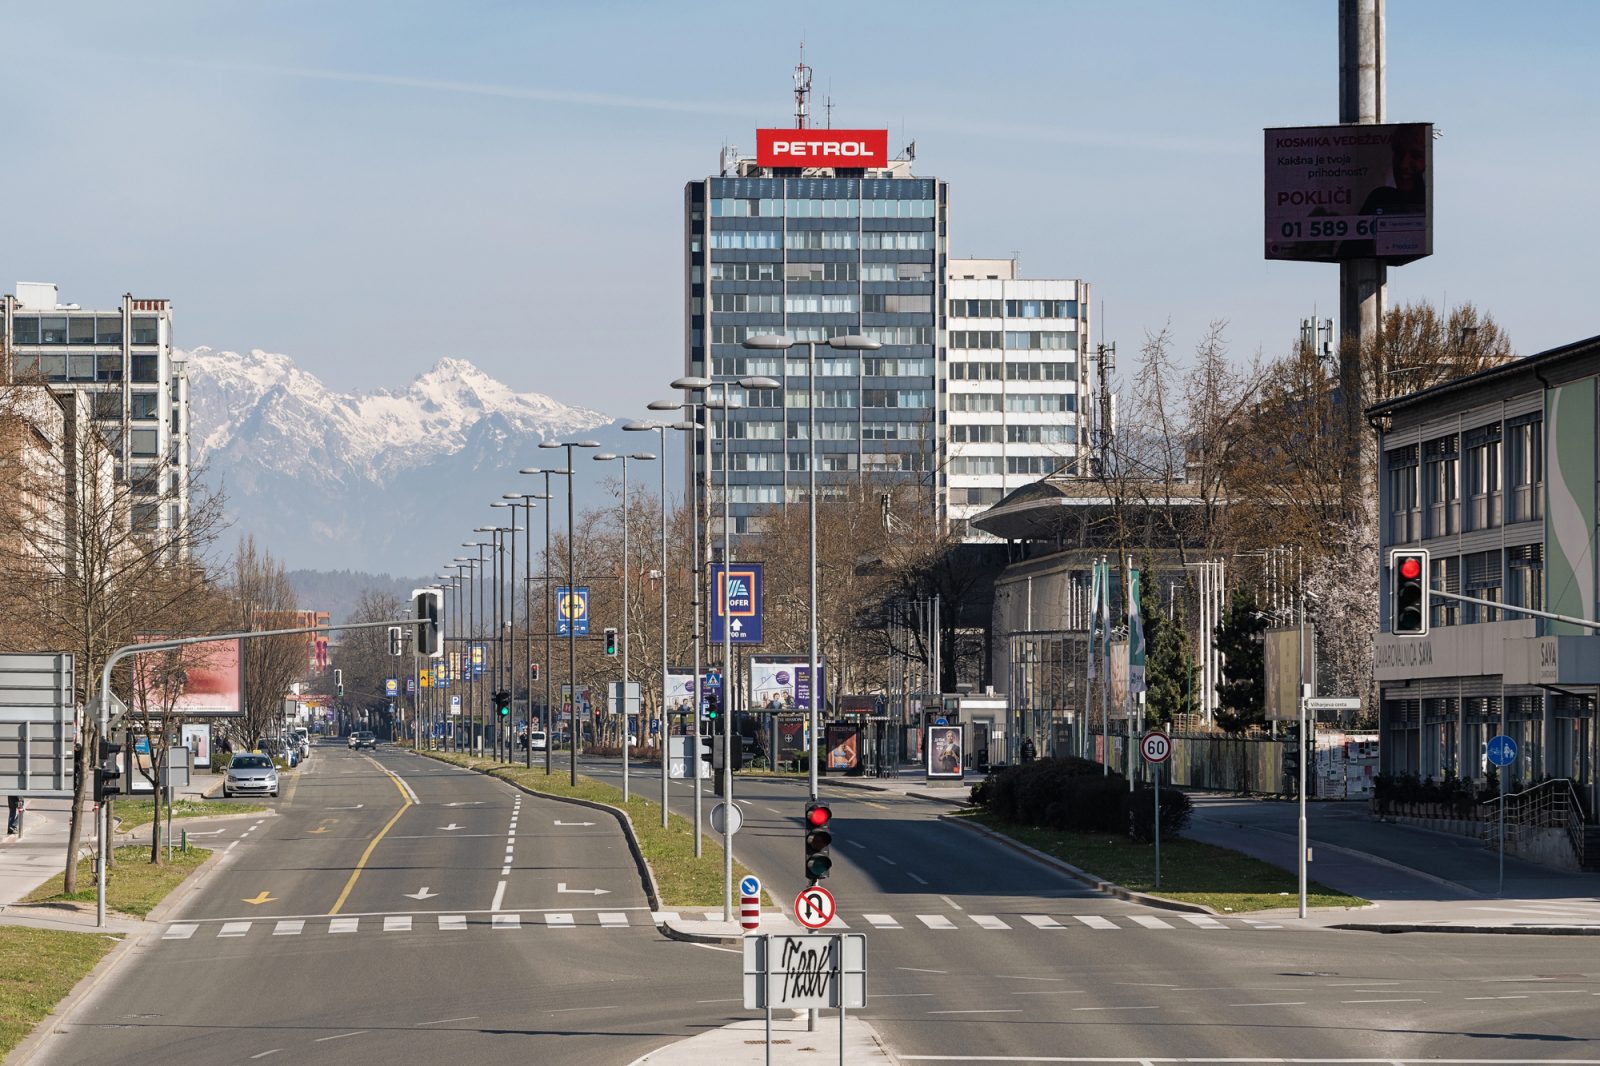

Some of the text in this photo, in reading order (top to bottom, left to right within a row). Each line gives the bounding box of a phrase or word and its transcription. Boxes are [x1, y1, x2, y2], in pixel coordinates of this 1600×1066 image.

[773, 141, 874, 156] PETROL
[1276, 136, 1330, 148] KOSMIKA
[1278, 154, 1351, 166] Kakšna je tvoja
[1308, 166, 1368, 179] prihodnost?
[1281, 222, 1302, 238] 01
[1310, 220, 1348, 237] 589
[727, 599, 749, 607] OFER
[1418, 640, 1433, 666] SAVA
[1541, 641, 1557, 667] SAVA
[452, 697, 459, 705] P
[1147, 740, 1164, 755] 60
